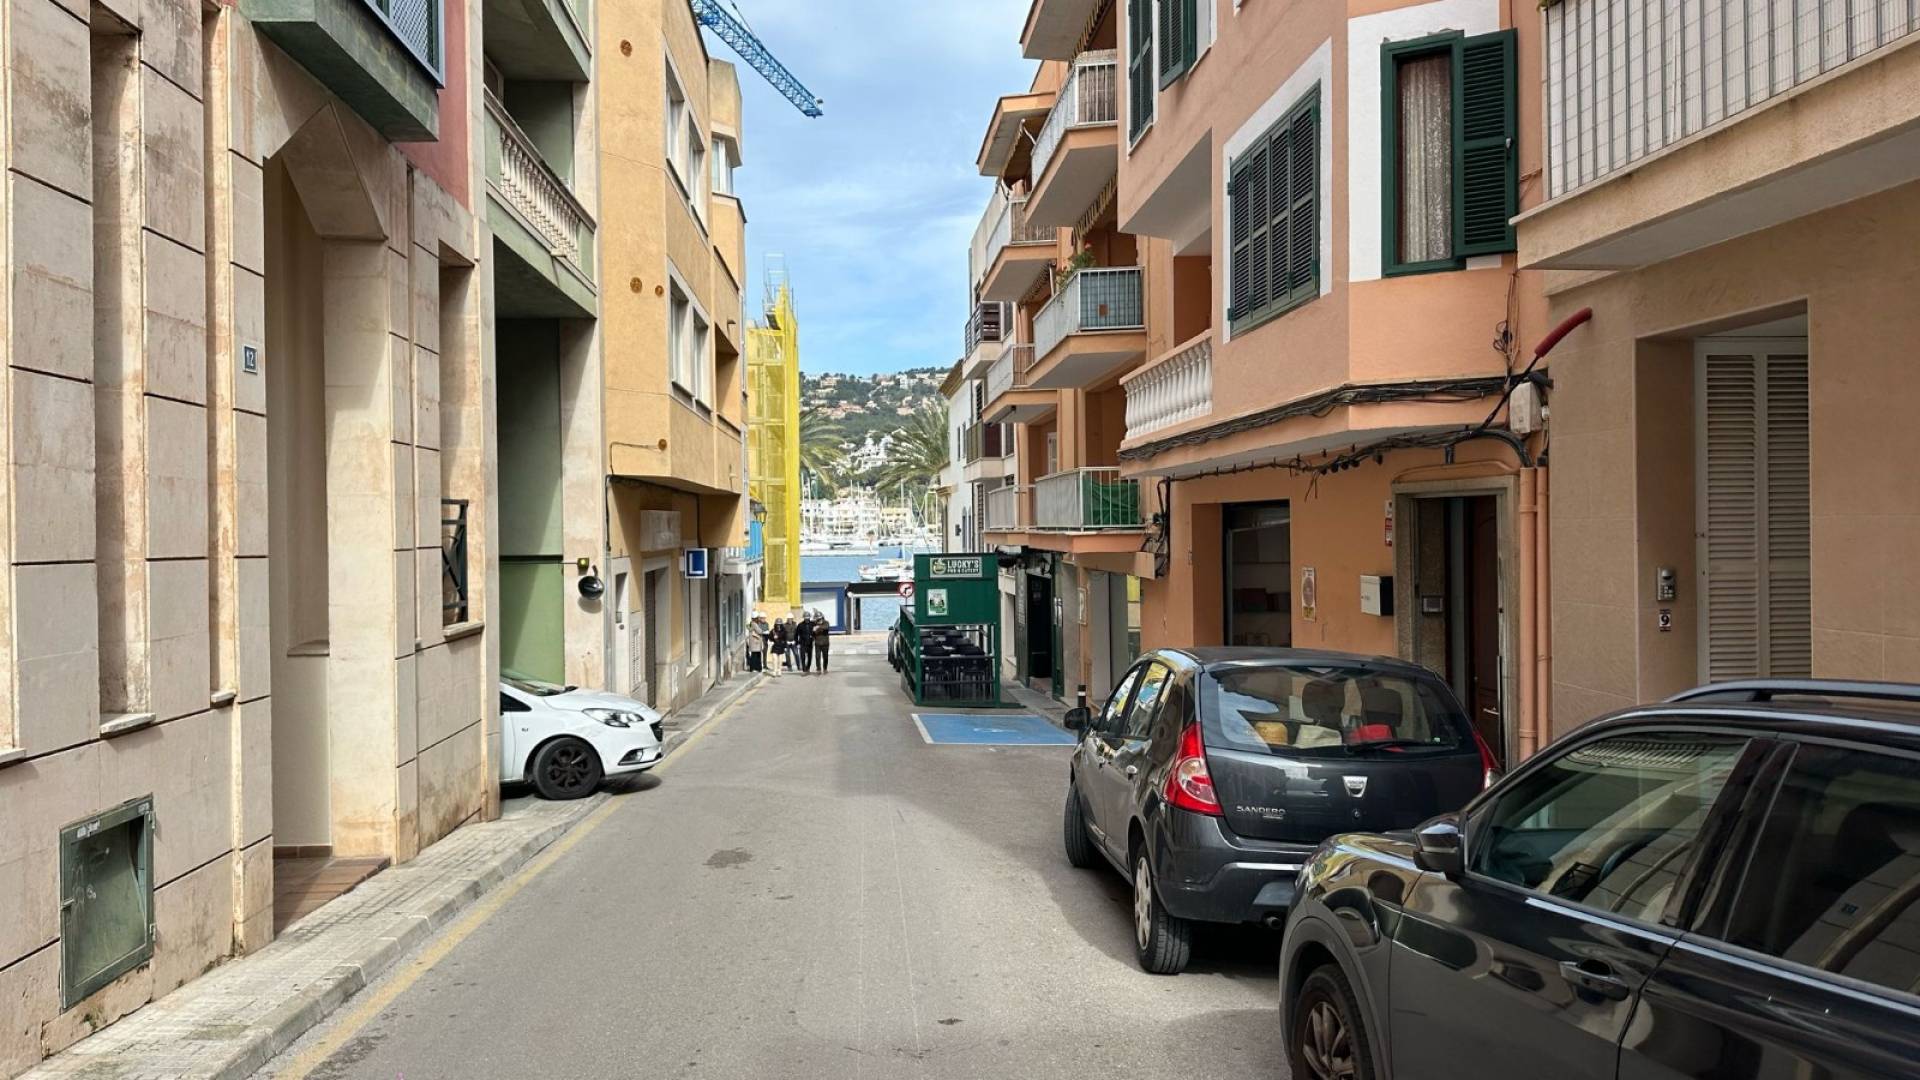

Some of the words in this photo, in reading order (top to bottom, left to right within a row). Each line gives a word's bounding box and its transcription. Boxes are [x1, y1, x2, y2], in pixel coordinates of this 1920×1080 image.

[246, 350, 254, 367] 12
[689, 553, 704, 574] L
[947, 560, 979, 569] LUCKY'S
[1661, 614, 1670, 626] 9
[1236, 805, 1286, 815] SANDERO
